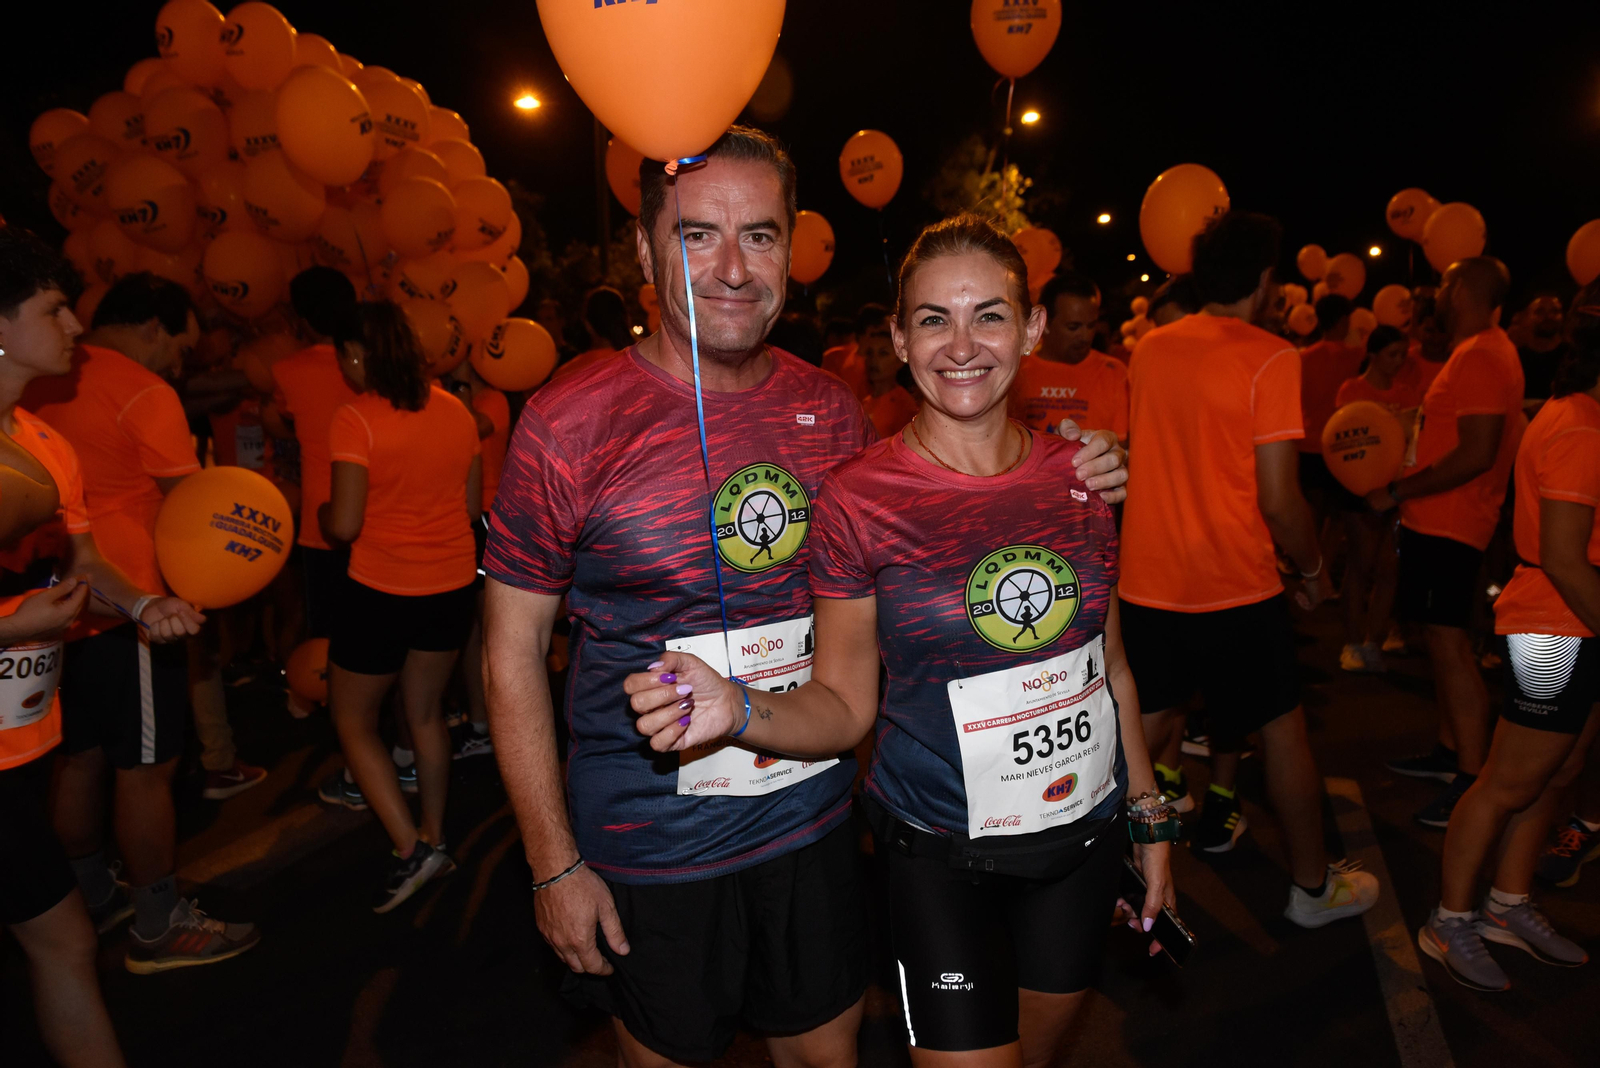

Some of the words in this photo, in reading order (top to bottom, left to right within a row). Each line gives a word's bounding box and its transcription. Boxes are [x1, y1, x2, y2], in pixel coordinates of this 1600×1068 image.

[1040, 386, 1078, 398] XXXV
[720, 469, 798, 513] LQDMM
[230, 502, 281, 533] XXXV
[717, 525, 735, 538] 20
[790, 510, 806, 521] 12
[224, 540, 263, 562] KH7
[975, 550, 1064, 591] LQDMM
[973, 603, 993, 615] 20
[1058, 586, 1075, 598] 12
[967, 720, 986, 731] XXXV
[987, 715, 1017, 727] CARRERA
[1017, 706, 1049, 720] NOCTURNA
[1048, 703, 1059, 711] DEL
[1514, 698, 1559, 712] BOMBEROS
[1518, 705, 1549, 715] SEVILLA
[1013, 710, 1092, 766] 5356
[1001, 772, 1025, 783] MARI
[1026, 764, 1054, 778] NIEVES
[1055, 753, 1083, 769] GARCIA
[1083, 742, 1100, 757] REYES
